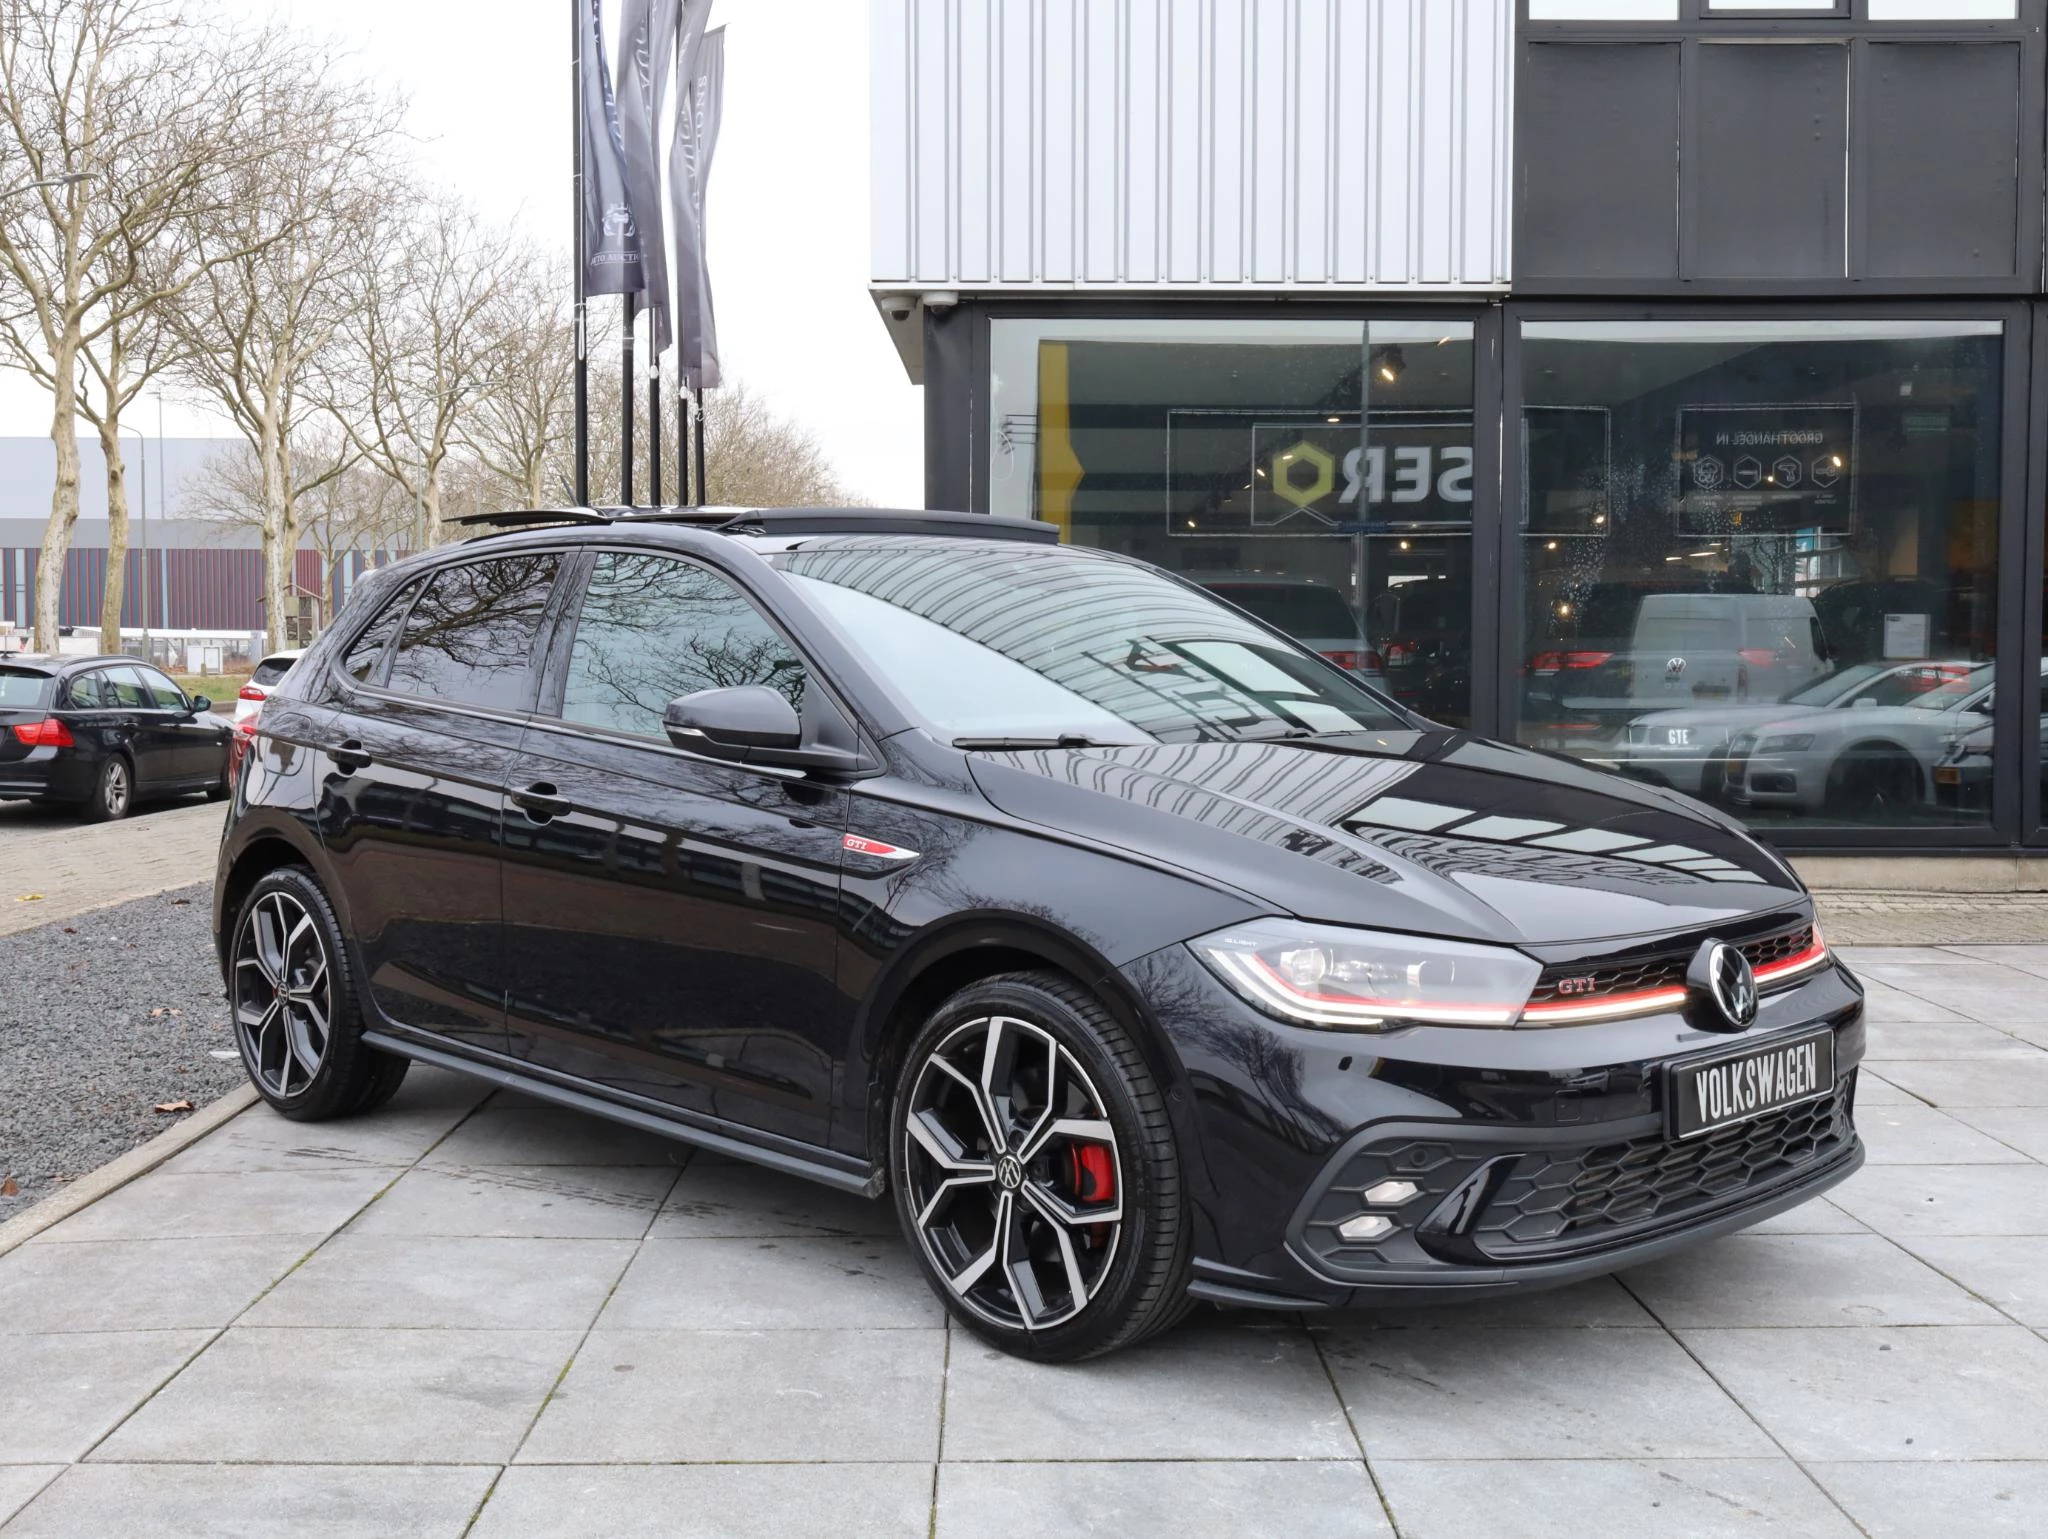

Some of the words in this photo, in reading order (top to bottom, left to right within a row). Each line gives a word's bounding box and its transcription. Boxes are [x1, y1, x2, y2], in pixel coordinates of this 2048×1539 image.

[1668, 728, 1689, 745] GTE
[846, 838, 868, 850] GTI
[1558, 976, 1596, 995] GTI
[1695, 1042, 1817, 1123] VOLKSWAGEN
